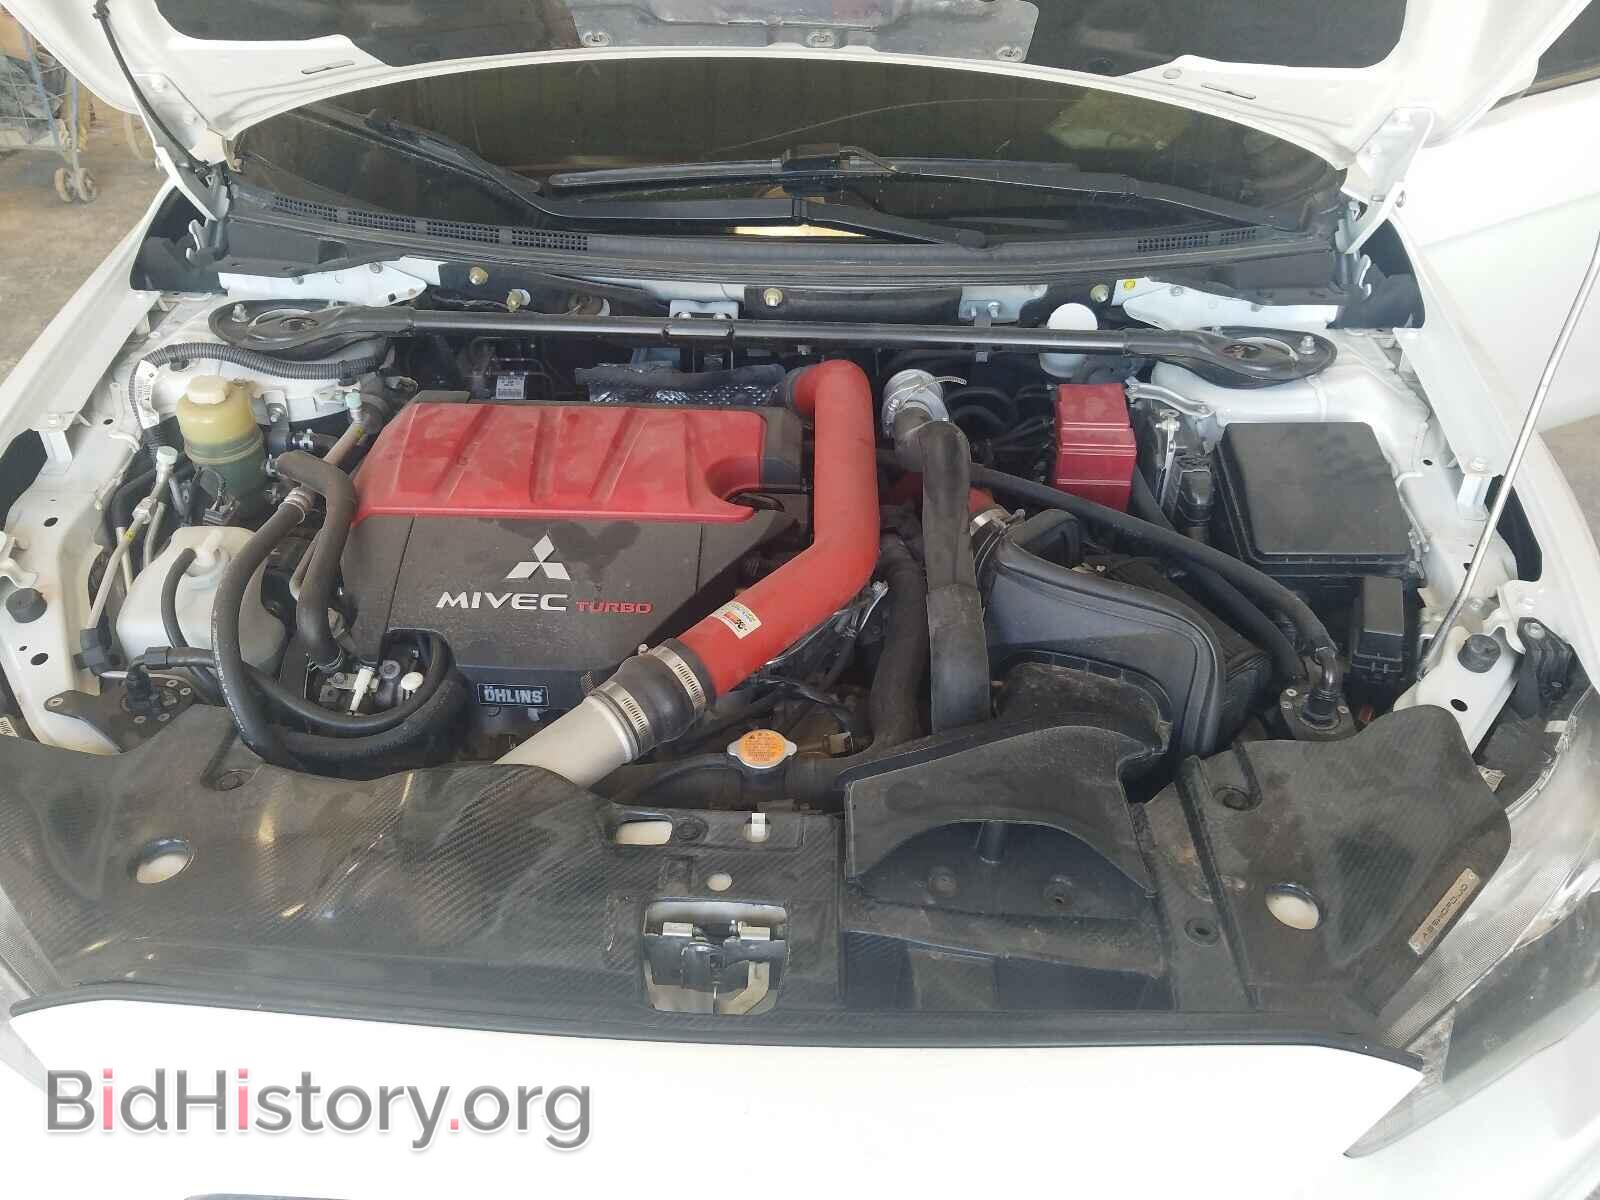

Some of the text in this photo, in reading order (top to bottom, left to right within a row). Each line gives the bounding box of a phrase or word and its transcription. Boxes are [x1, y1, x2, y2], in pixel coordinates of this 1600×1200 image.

[436, 591, 653, 614] MIVEC TURBO
[484, 686, 543, 704] ÖHLINS
